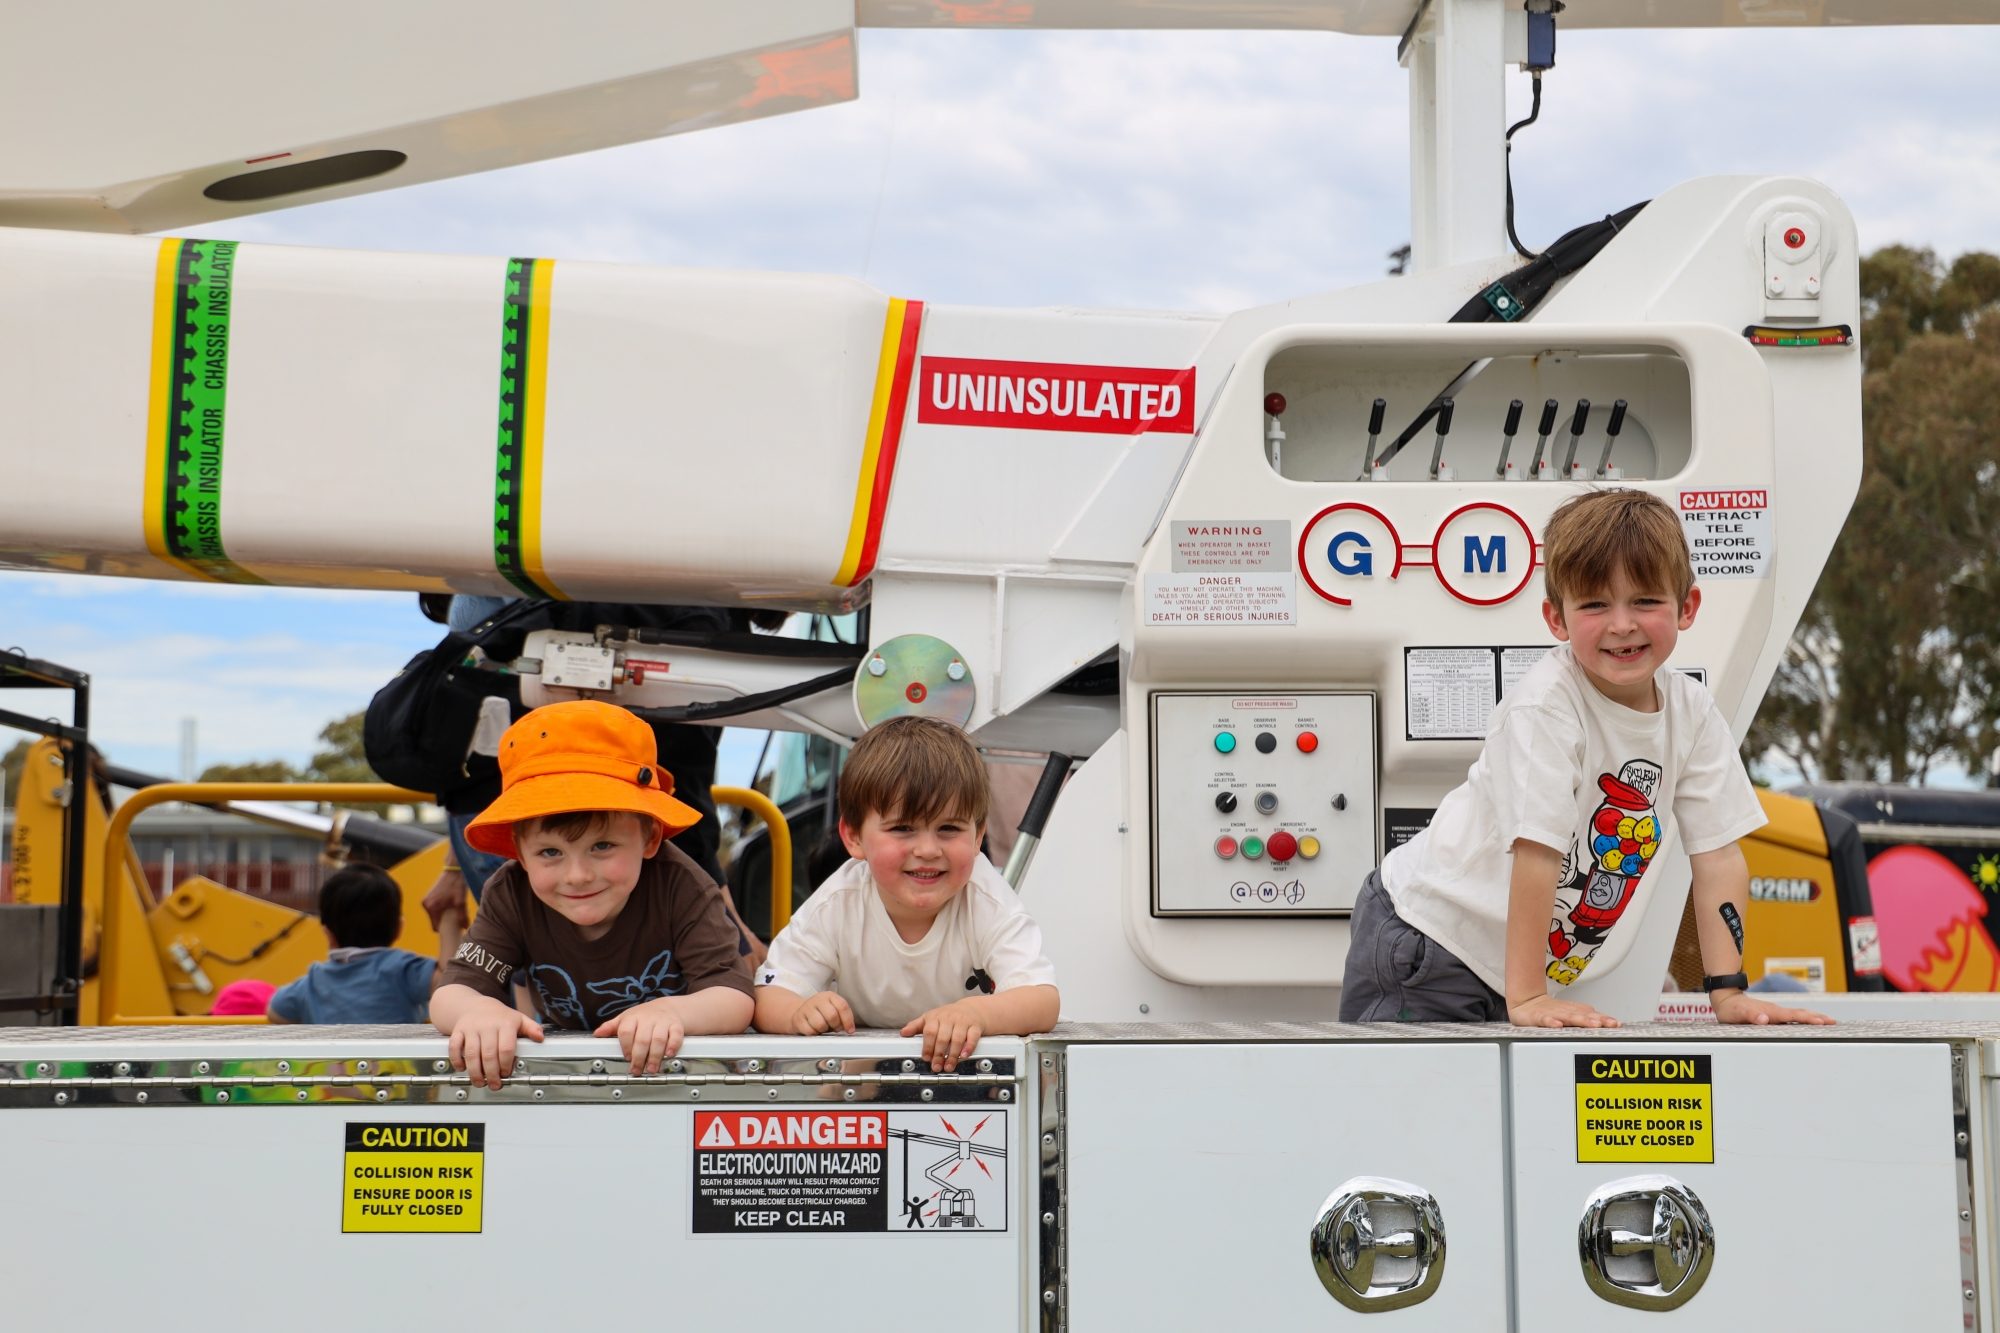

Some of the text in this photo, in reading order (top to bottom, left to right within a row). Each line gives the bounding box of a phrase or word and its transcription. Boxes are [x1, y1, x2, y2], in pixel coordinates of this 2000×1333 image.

[204, 242, 235, 390] CHASSIS INSULATOR
[932, 372, 1182, 422] UNINSULATED
[198, 408, 222, 494] INSULATOR
[1682, 492, 1765, 509] CAUTION
[1685, 511, 1762, 522] RETRACT
[1188, 527, 1263, 536] WARNING
[1705, 524, 1744, 534] TELE
[1694, 537, 1756, 548] BEFORE
[1690, 551, 1762, 562] STOWING
[1697, 565, 1755, 575] BOOMS
[1152, 613, 1290, 621] DEATH OR SERIOUS INJURIES
[1750, 877, 1810, 901] 926M
[1591, 1059, 1695, 1079] CAUTION
[1585, 1098, 1702, 1110] COLLISION RISK
[1586, 1119, 1703, 1130] ENSURE DOOR IS
[739, 1116, 884, 1145] DANGER
[362, 1127, 468, 1147] CAUTION
[1596, 1135, 1694, 1146] FULLY CLOSED
[700, 1153, 881, 1175] ELECTROCUTION HAZARD
[354, 1167, 473, 1178] COLLISION RISK
[354, 1189, 472, 1200] ENSURE DOOR IS
[362, 1205, 463, 1215] FULLY CLOSED
[734, 1211, 845, 1226] KEEP CLEAR
